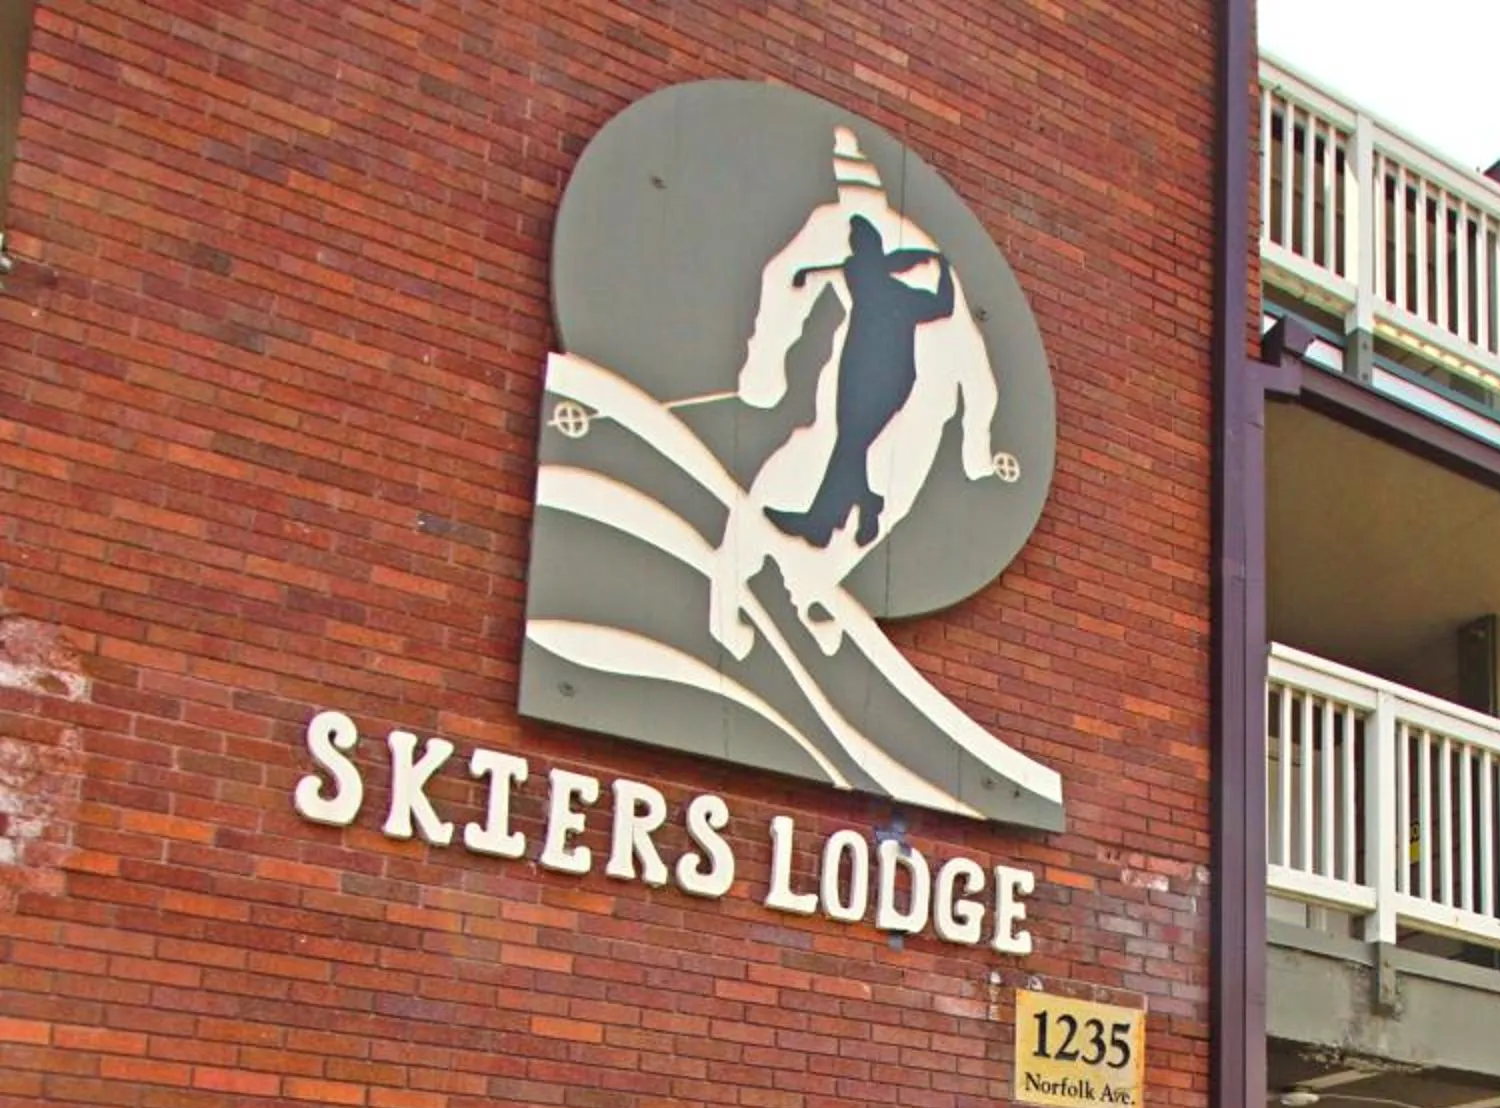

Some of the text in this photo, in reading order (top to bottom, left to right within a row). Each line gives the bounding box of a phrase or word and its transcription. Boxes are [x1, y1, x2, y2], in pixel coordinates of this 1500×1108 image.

[295, 710, 1036, 956] SKIERS LODGE
[1032, 1009, 1131, 1070] 1235
[1024, 1071, 1136, 1106] Norfolk Ave.
